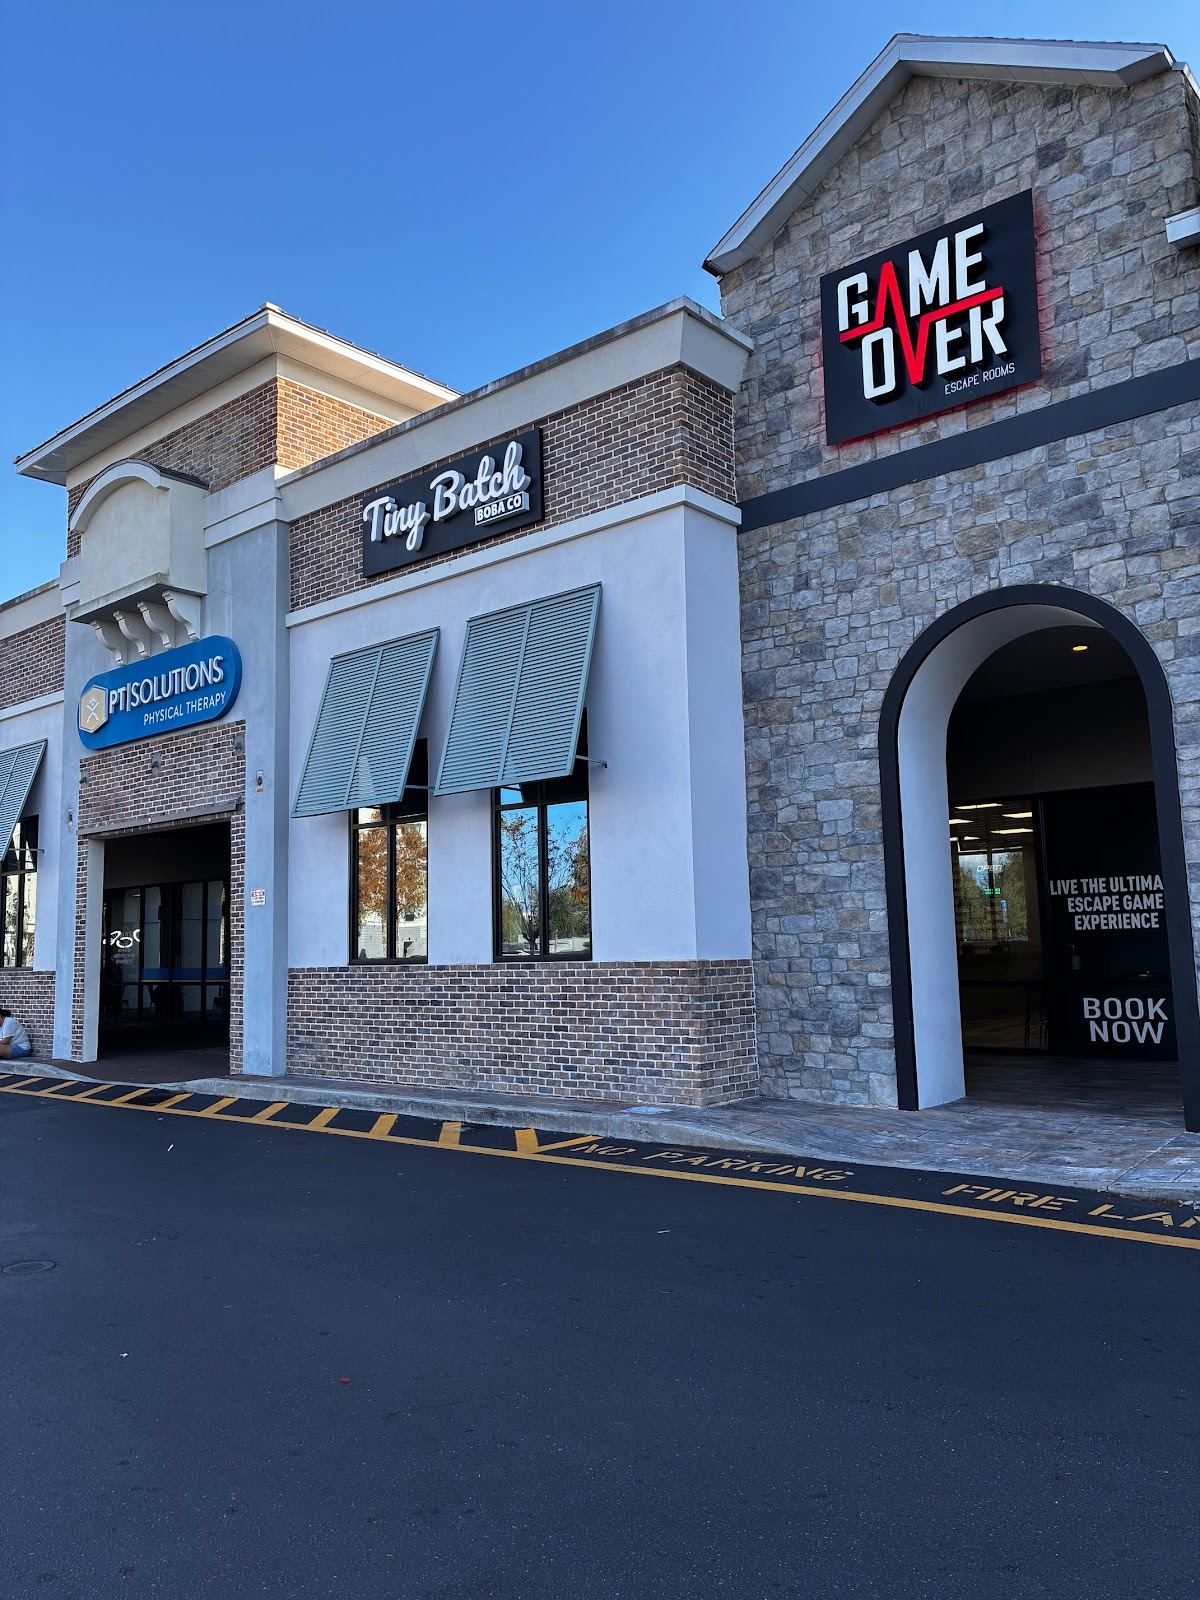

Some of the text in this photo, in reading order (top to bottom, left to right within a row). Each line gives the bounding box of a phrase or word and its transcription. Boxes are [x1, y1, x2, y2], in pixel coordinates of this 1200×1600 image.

[838, 222, 986, 332] GAME
[861, 297, 1008, 400] OVER
[944, 362, 1016, 395] ESCAPE ROOMS
[362, 440, 531, 551] Tiny Batch
[476, 495, 522, 522] BOBA CO
[143, 691, 227, 726] PHYSICAL THERAPY
[1050, 878, 1078, 896] LIVE
[1080, 877, 1107, 895] THE
[1067, 893, 1164, 913] ESCAPE GAME
[1074, 912, 1160, 931] EXPERIENCE
[1082, 997, 1169, 1020] BOOK
[1089, 1020, 1165, 1044] NOW
[571, 1143, 636, 1157] NO
[642, 1151, 855, 1181] PARKING
[941, 1183, 1079, 1211] FIRE
